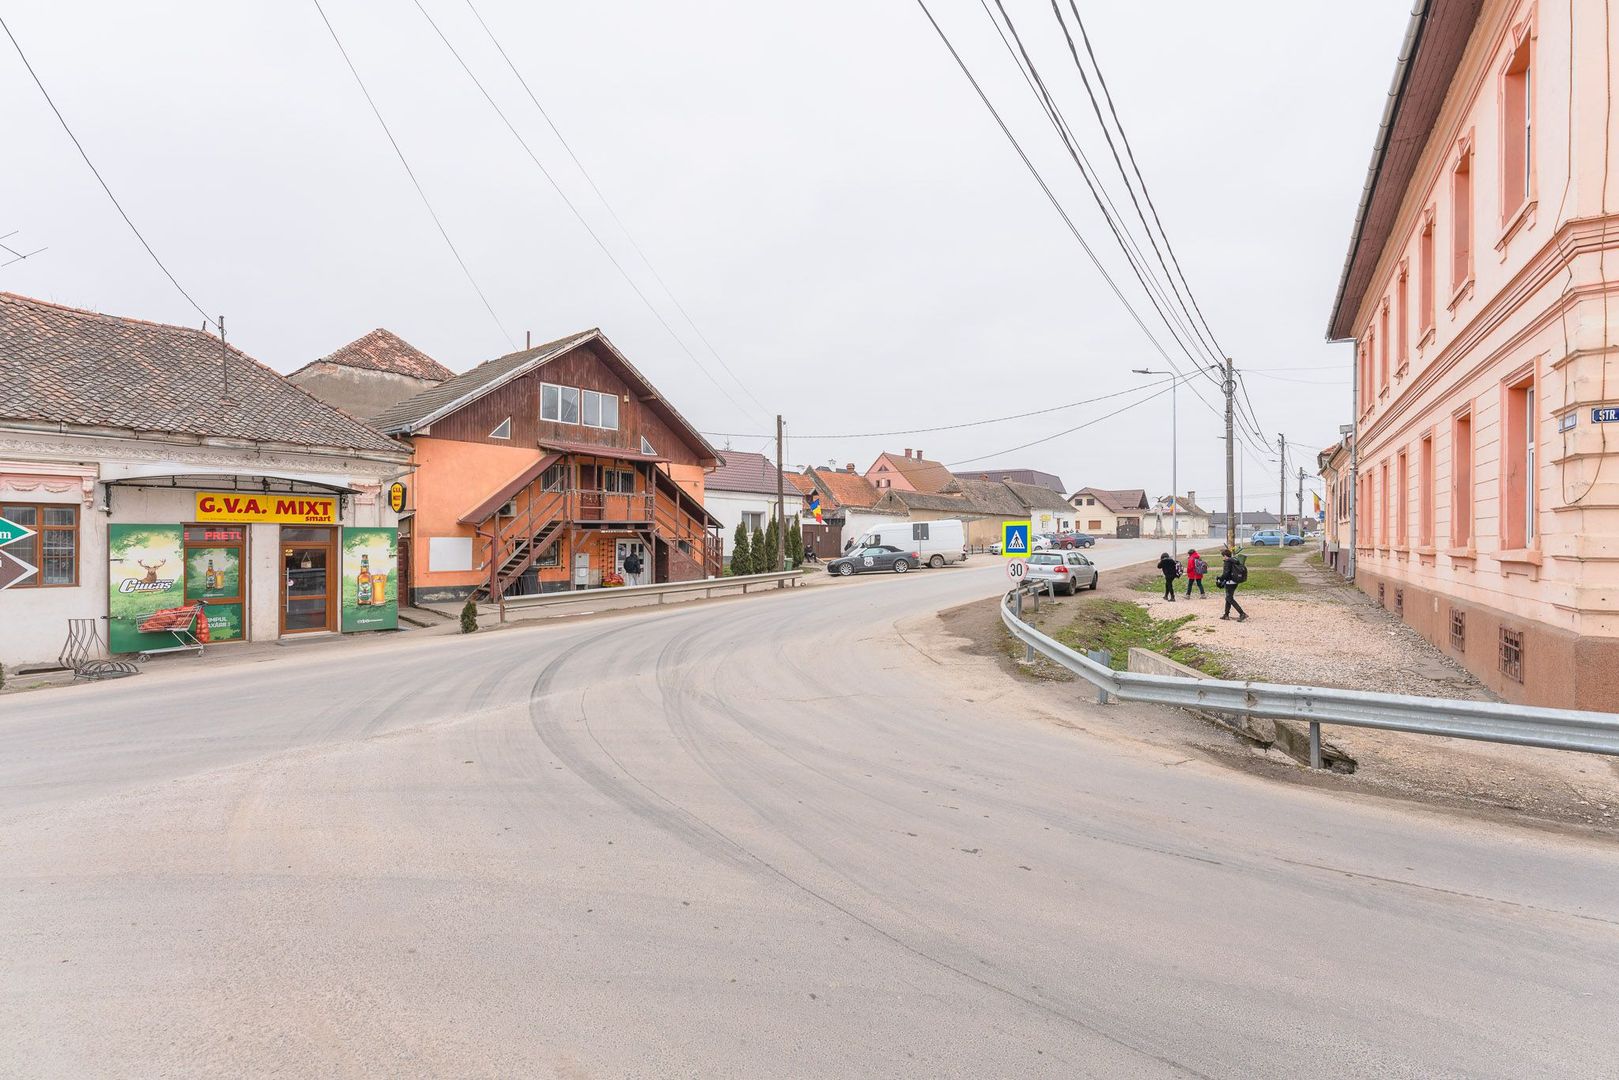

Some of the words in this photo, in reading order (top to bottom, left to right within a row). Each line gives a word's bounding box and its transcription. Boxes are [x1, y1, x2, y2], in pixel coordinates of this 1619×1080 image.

[1599, 410, 1618, 419] STR.
[199, 497, 267, 514] G.V.A.
[275, 500, 332, 515] MIXT
[1010, 563, 1022, 576] 30
